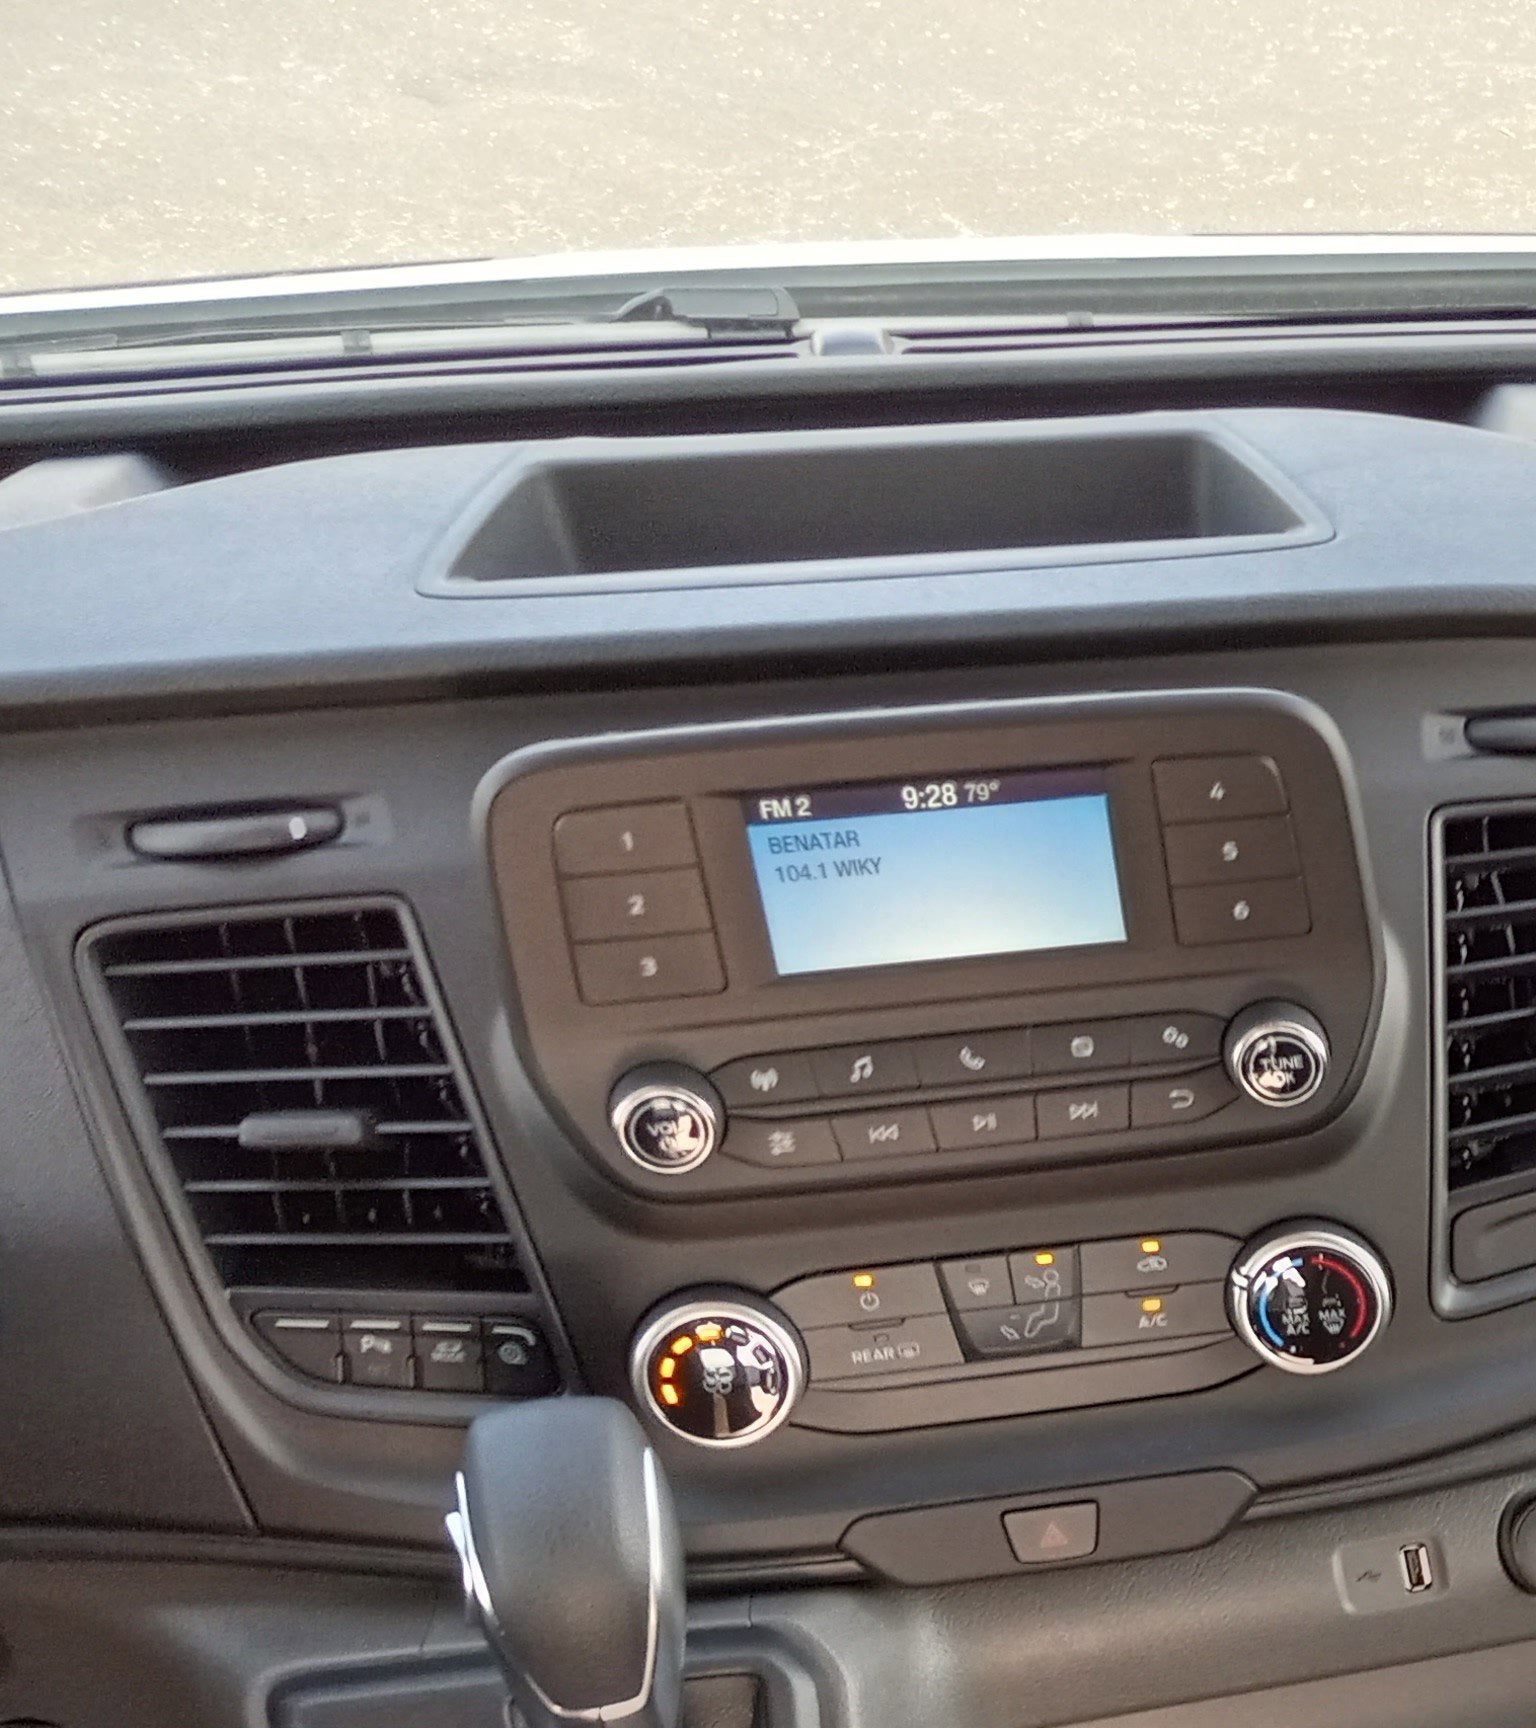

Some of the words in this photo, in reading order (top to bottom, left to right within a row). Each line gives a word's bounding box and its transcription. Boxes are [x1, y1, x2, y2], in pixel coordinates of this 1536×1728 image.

[901, 783, 957, 809] 9:28
[1210, 781, 1226, 800] 4
[758, 799, 792, 820] FM
[796, 797, 812, 817] 2
[621, 830, 634, 851] 1
[768, 830, 860, 854] BENATAR
[1222, 841, 1239, 861] 5
[775, 861, 828, 883] 104.1
[834, 857, 882, 878] WIKY
[628, 894, 646, 916] 2
[1233, 900, 1250, 921] 6
[640, 956, 658, 977] 3
[1139, 1313, 1167, 1329] A/C
[851, 1346, 895, 1365] REAR
